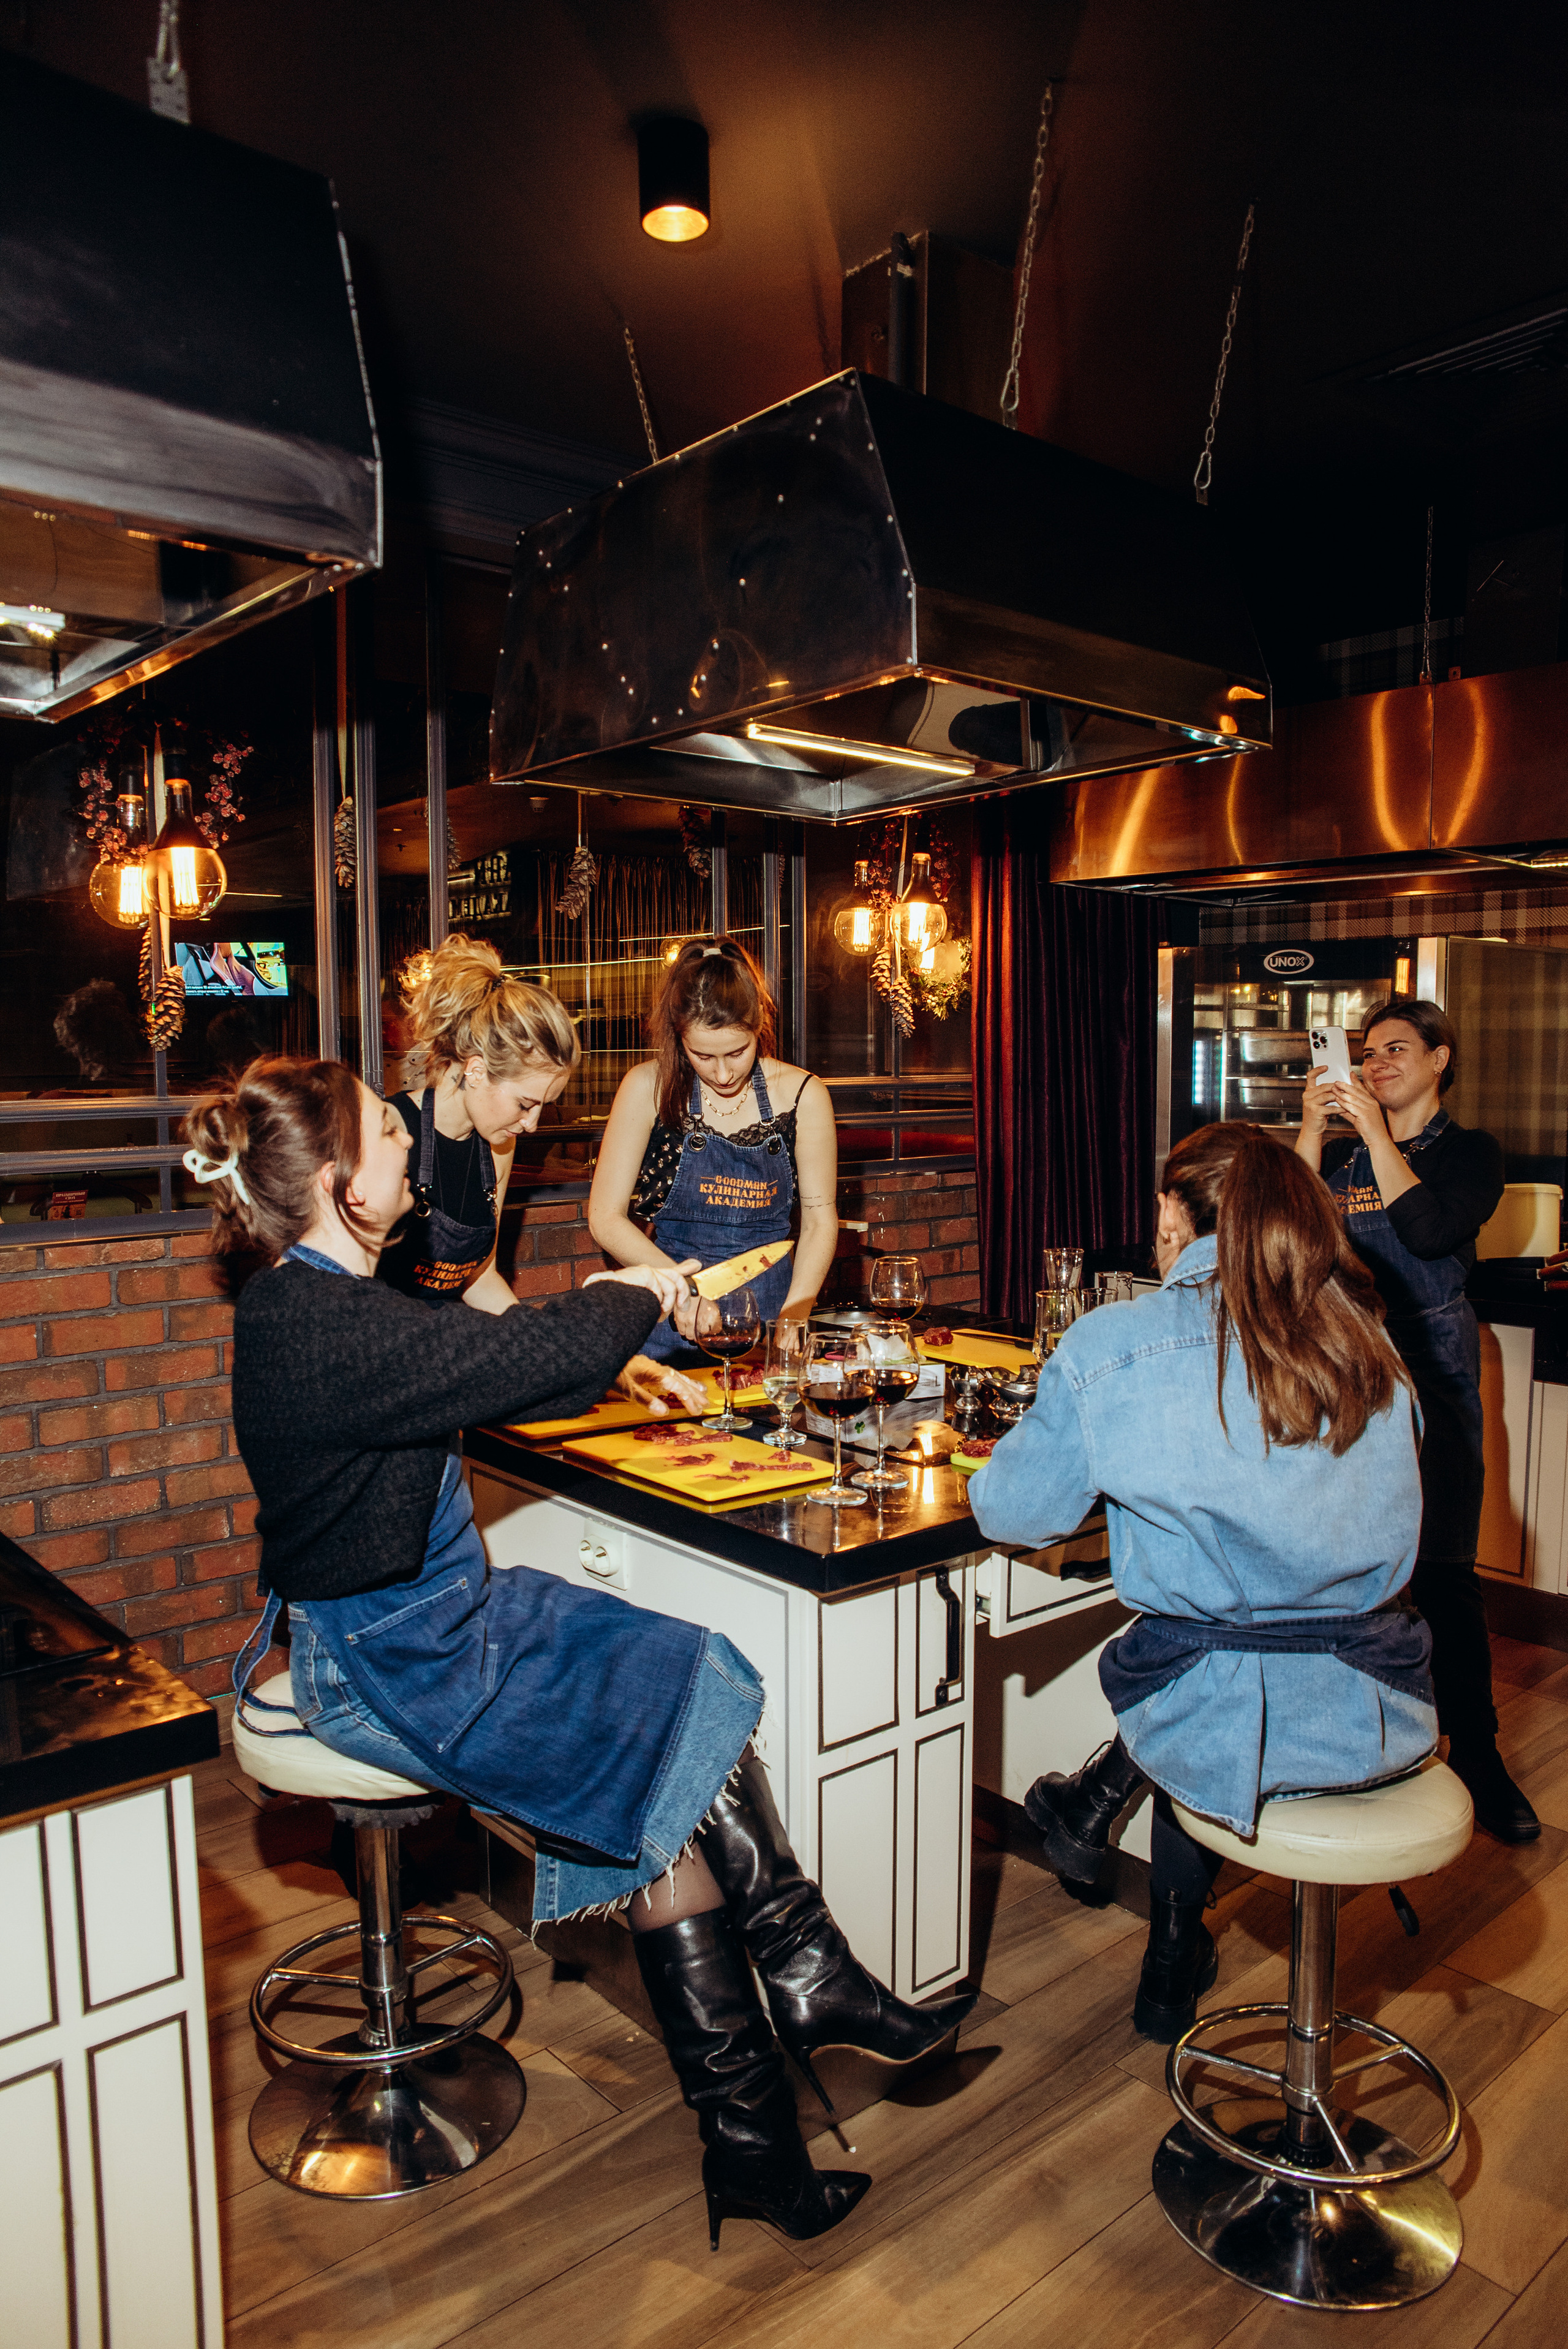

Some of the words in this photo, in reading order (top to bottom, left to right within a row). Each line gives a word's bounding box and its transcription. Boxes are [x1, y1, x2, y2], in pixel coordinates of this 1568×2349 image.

[1270, 956, 1305, 967] UNOX
[715, 1175, 767, 1190] GOODMAN
[699, 1183, 778, 1199] КУЛИНАРНАЯ
[706, 1195, 771, 1209] АКАДЕМИЯ
